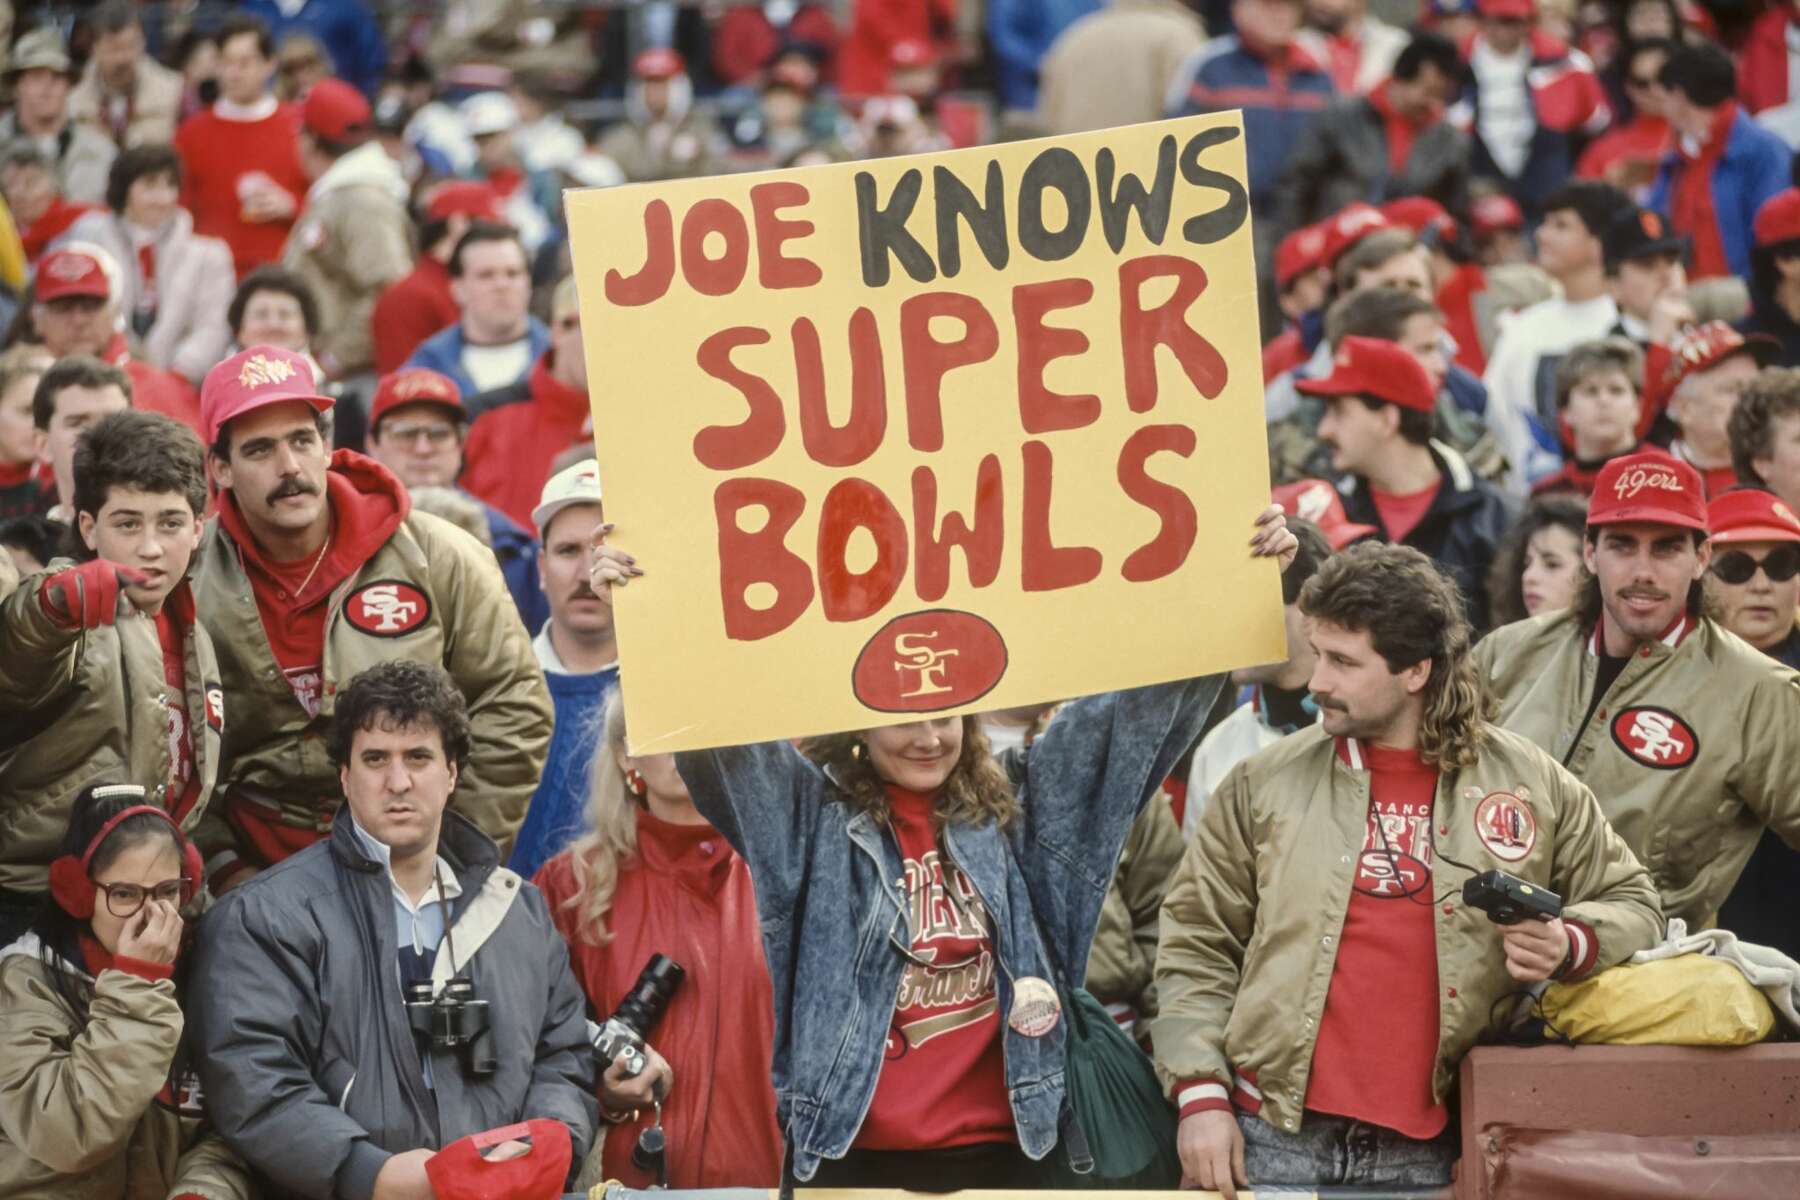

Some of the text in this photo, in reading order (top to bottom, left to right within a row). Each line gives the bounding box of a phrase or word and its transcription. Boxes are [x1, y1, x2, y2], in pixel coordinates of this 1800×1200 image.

[605, 127, 1248, 306] JOE KNOWS
[694, 255, 1227, 470] SUPER
[1614, 470, 1684, 500] 49ers
[714, 425, 1197, 641] BOWLS
[361, 585, 417, 631] SF
[894, 630, 960, 698] SF
[1629, 710, 1685, 762] SF
